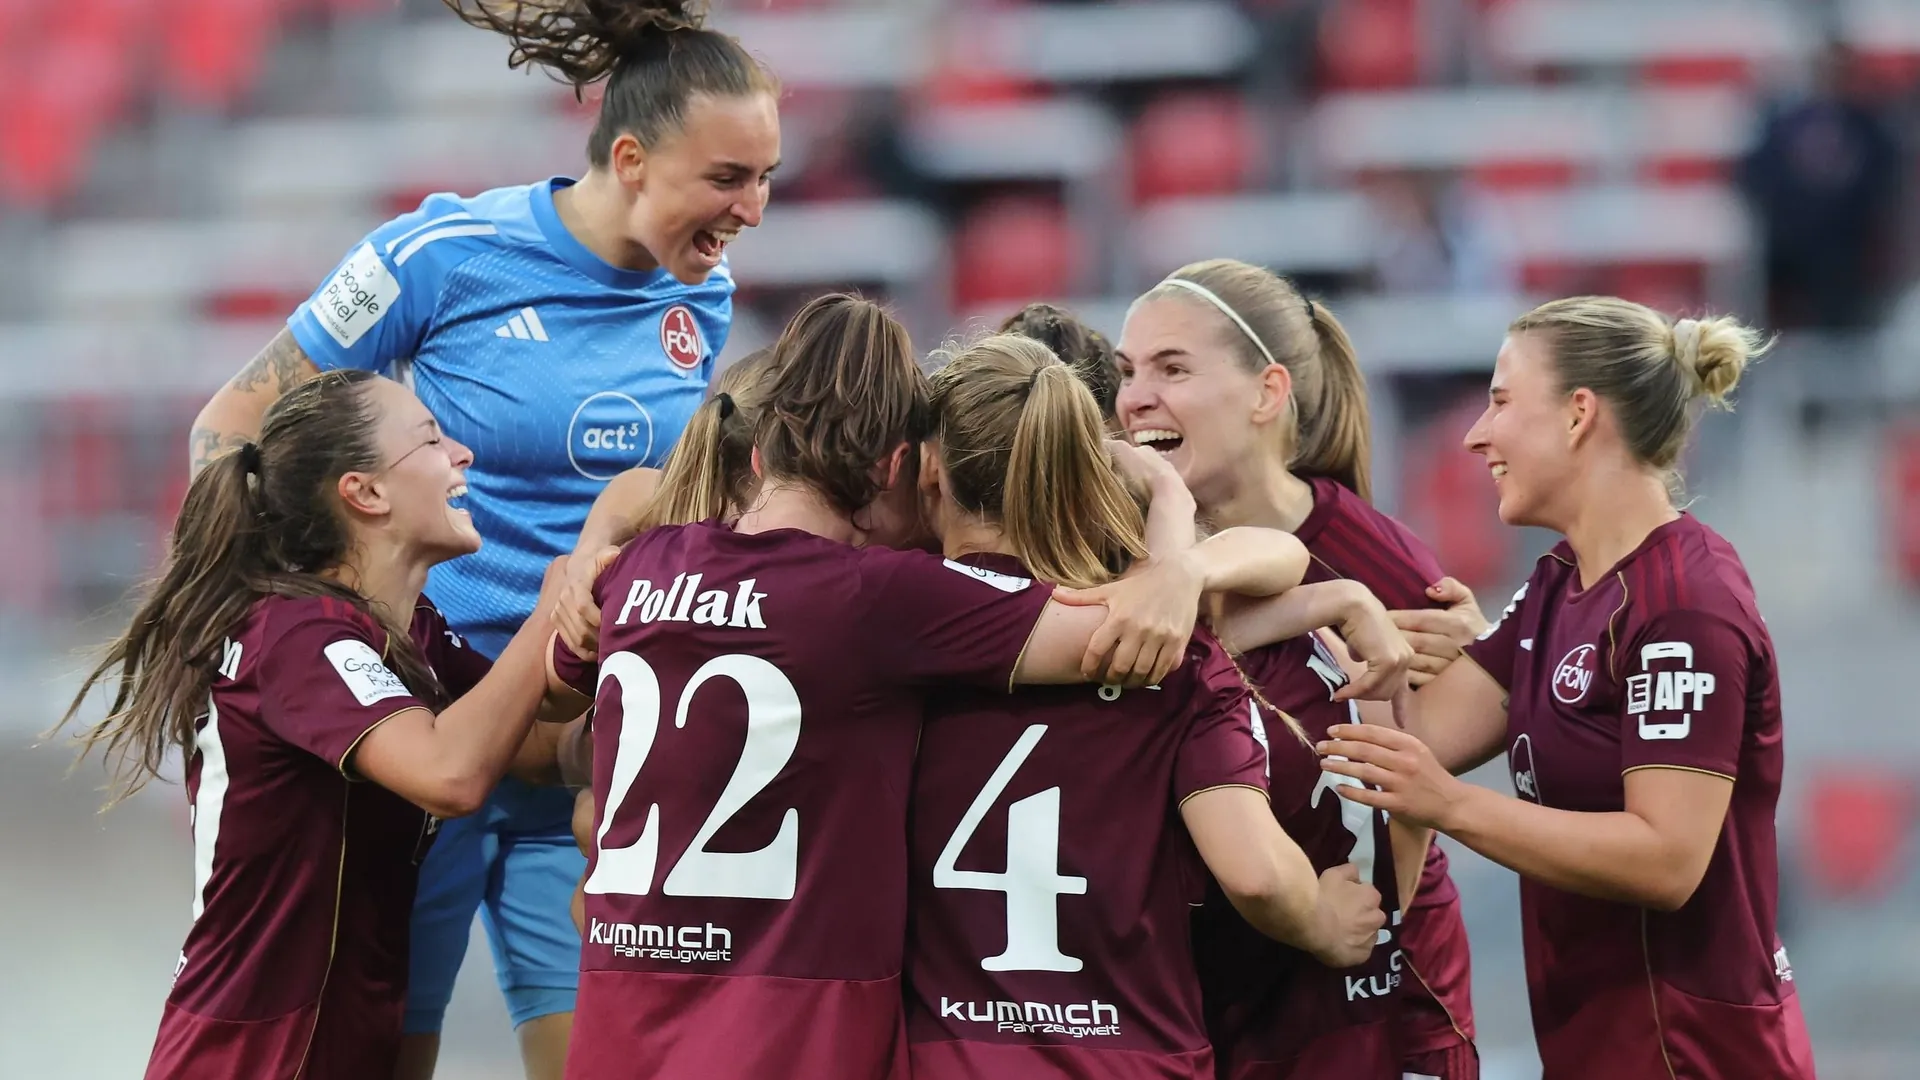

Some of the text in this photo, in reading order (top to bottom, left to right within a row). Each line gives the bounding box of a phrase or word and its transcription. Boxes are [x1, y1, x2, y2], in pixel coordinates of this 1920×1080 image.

[324, 284, 358, 323] Pixel
[666, 330, 698, 357] FCN
[615, 571, 768, 629] Pollak
[344, 657, 393, 678] Goog
[366, 673, 404, 687] Pixe
[1555, 664, 1590, 691] FCN
[1654, 671, 1716, 711] APP
[584, 650, 802, 900] 22
[933, 724, 1087, 972] 4
[589, 917, 732, 949] kummich
[614, 944, 732, 963] Fahrzeugwelt
[941, 996, 1118, 1025] kummich
[997, 1021, 1121, 1038] Fahrzeugwelt
